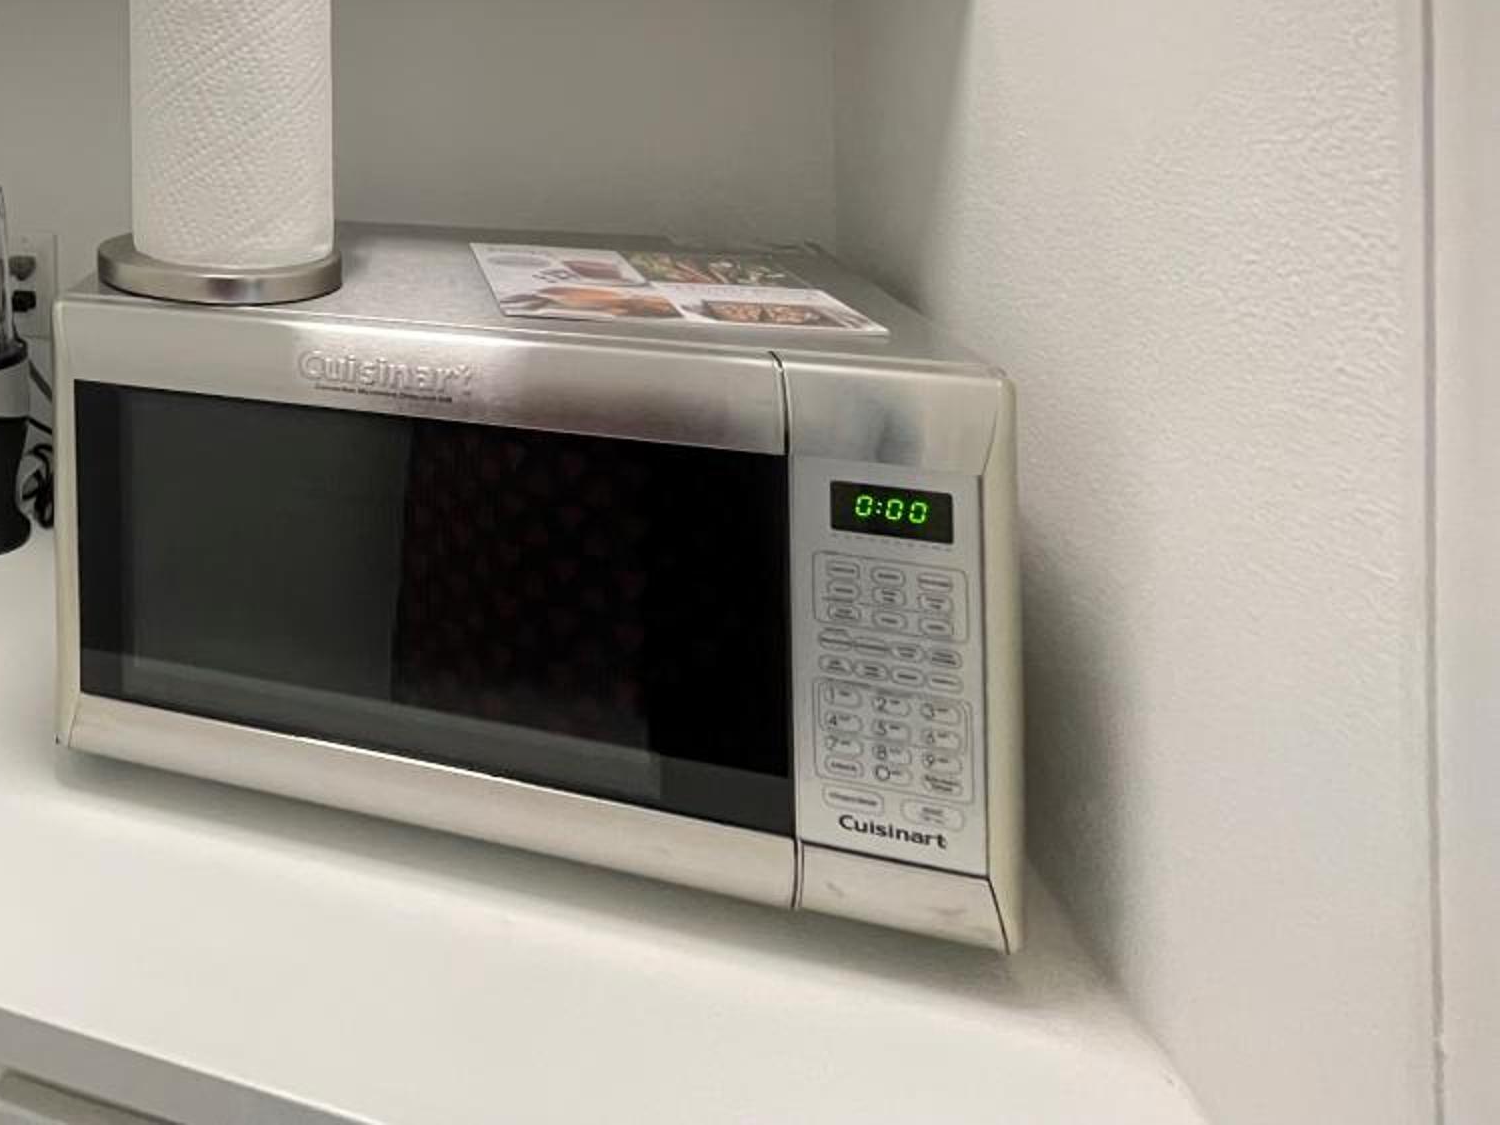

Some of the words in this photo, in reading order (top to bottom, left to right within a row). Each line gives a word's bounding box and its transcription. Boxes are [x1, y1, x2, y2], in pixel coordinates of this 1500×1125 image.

[298, 349, 472, 394] Cuisinart
[855, 495, 928, 524] 0:00
[838, 814, 948, 849] Cuisinart
